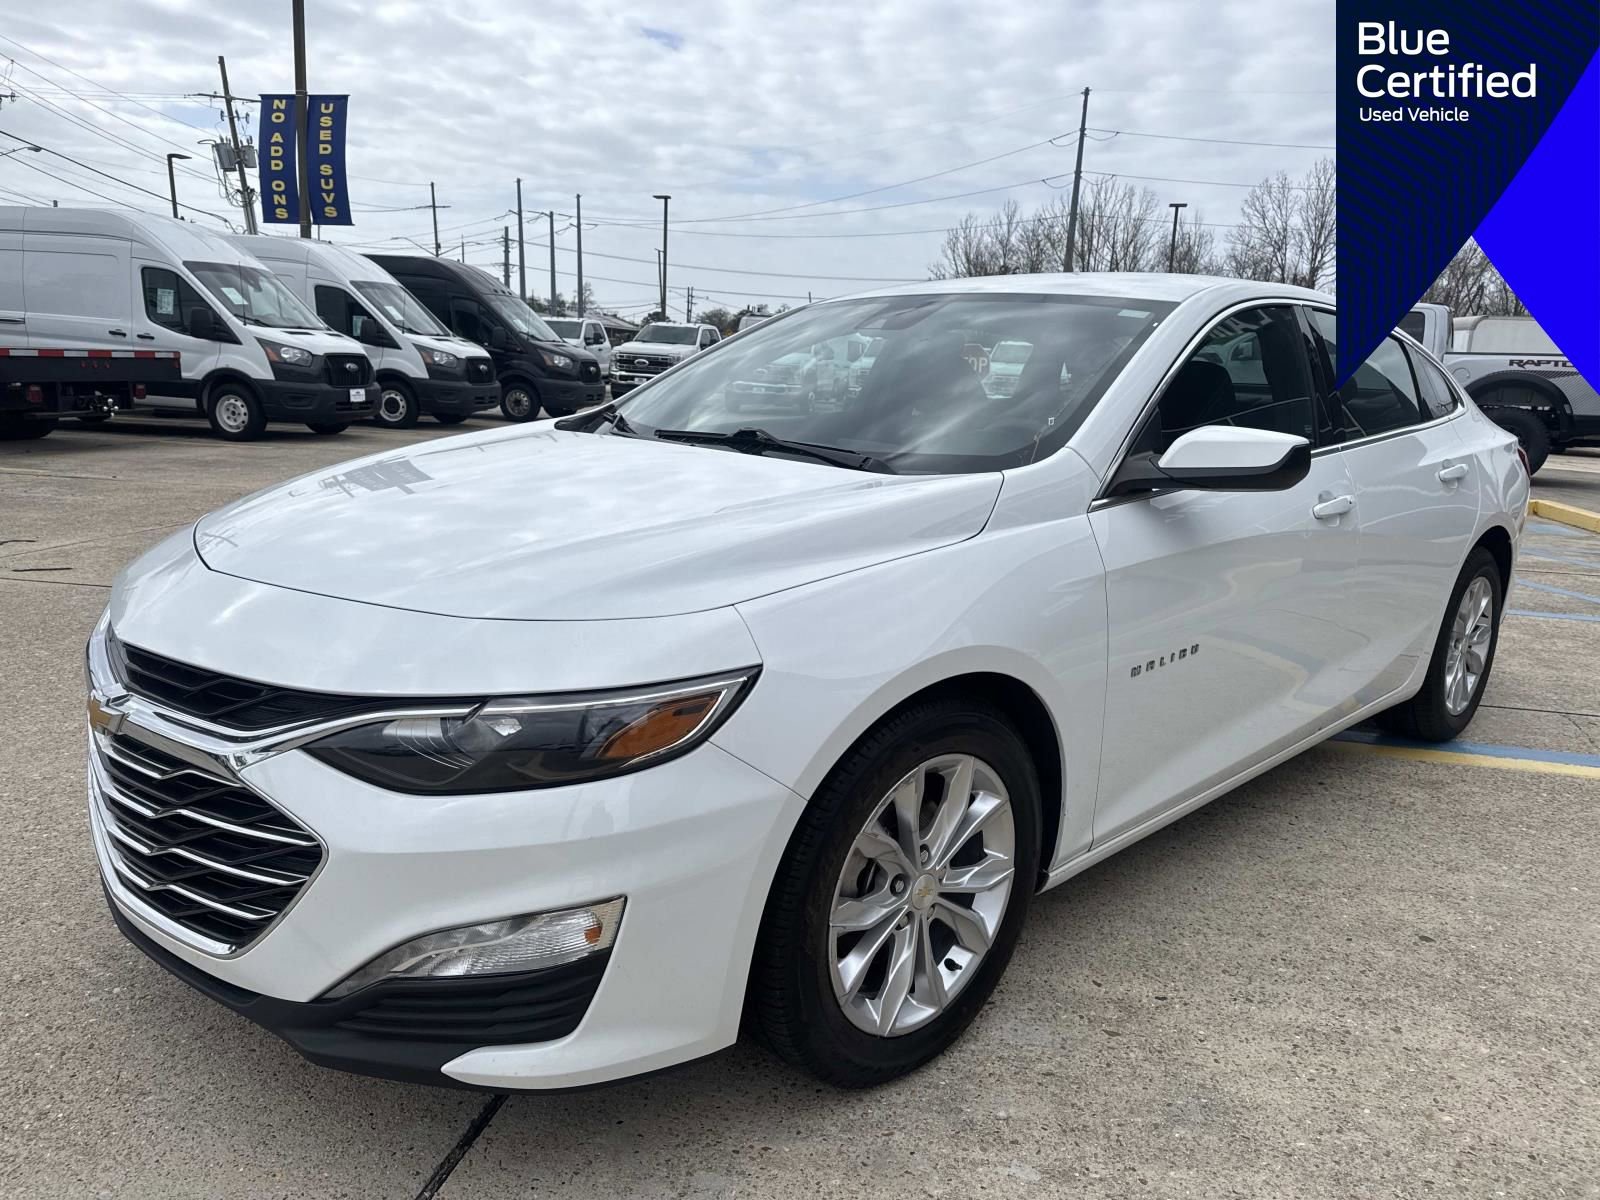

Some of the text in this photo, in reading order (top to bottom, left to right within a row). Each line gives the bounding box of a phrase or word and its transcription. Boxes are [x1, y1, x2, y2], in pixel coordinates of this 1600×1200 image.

[270, 99, 289, 219] NO ADD ONS
[318, 103, 338, 218] USED SUVS
[1508, 359, 1575, 370] RAPTO
[1130, 643, 1200, 678] MALIBU
